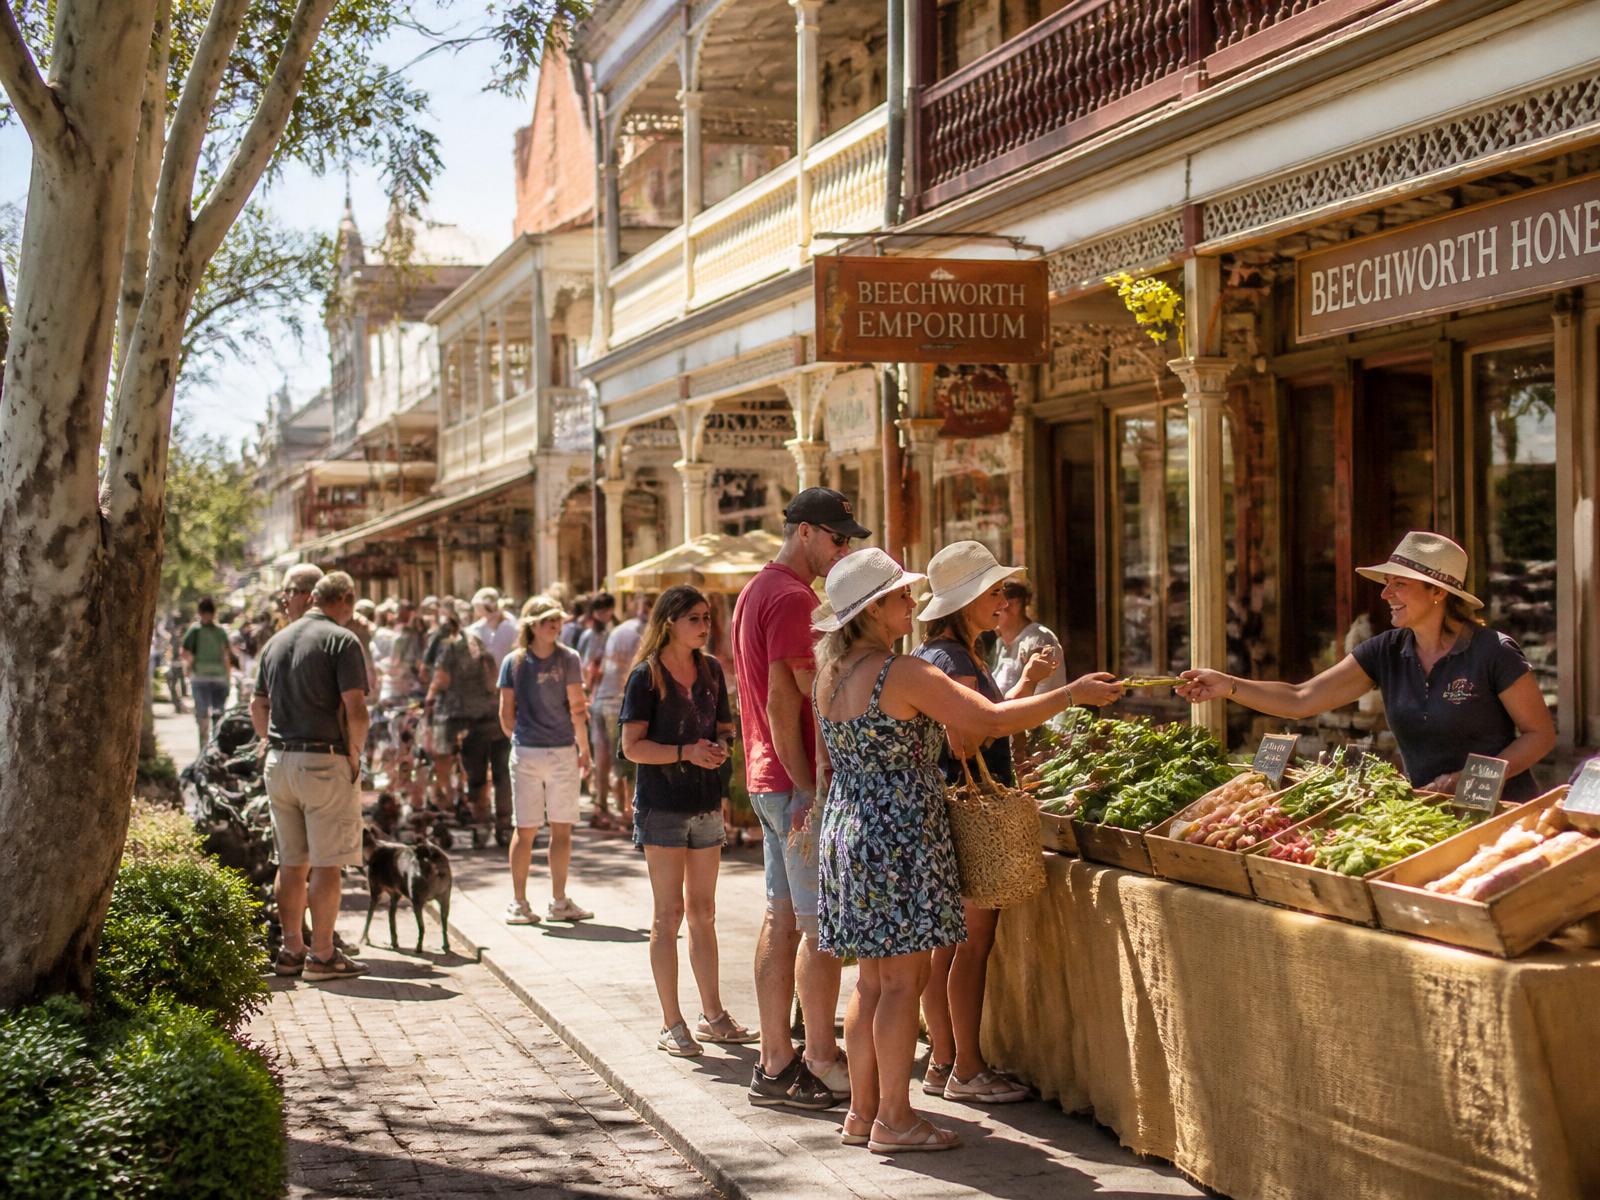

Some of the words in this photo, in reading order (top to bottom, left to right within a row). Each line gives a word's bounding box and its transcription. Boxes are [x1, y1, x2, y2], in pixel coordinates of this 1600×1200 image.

[1311, 225, 1498, 316] BEECHWORTH
[1510, 200, 1600, 271] HONE
[857, 281, 1026, 306] BEECHWORTH
[857, 310, 1026, 339] EMPORIUM
